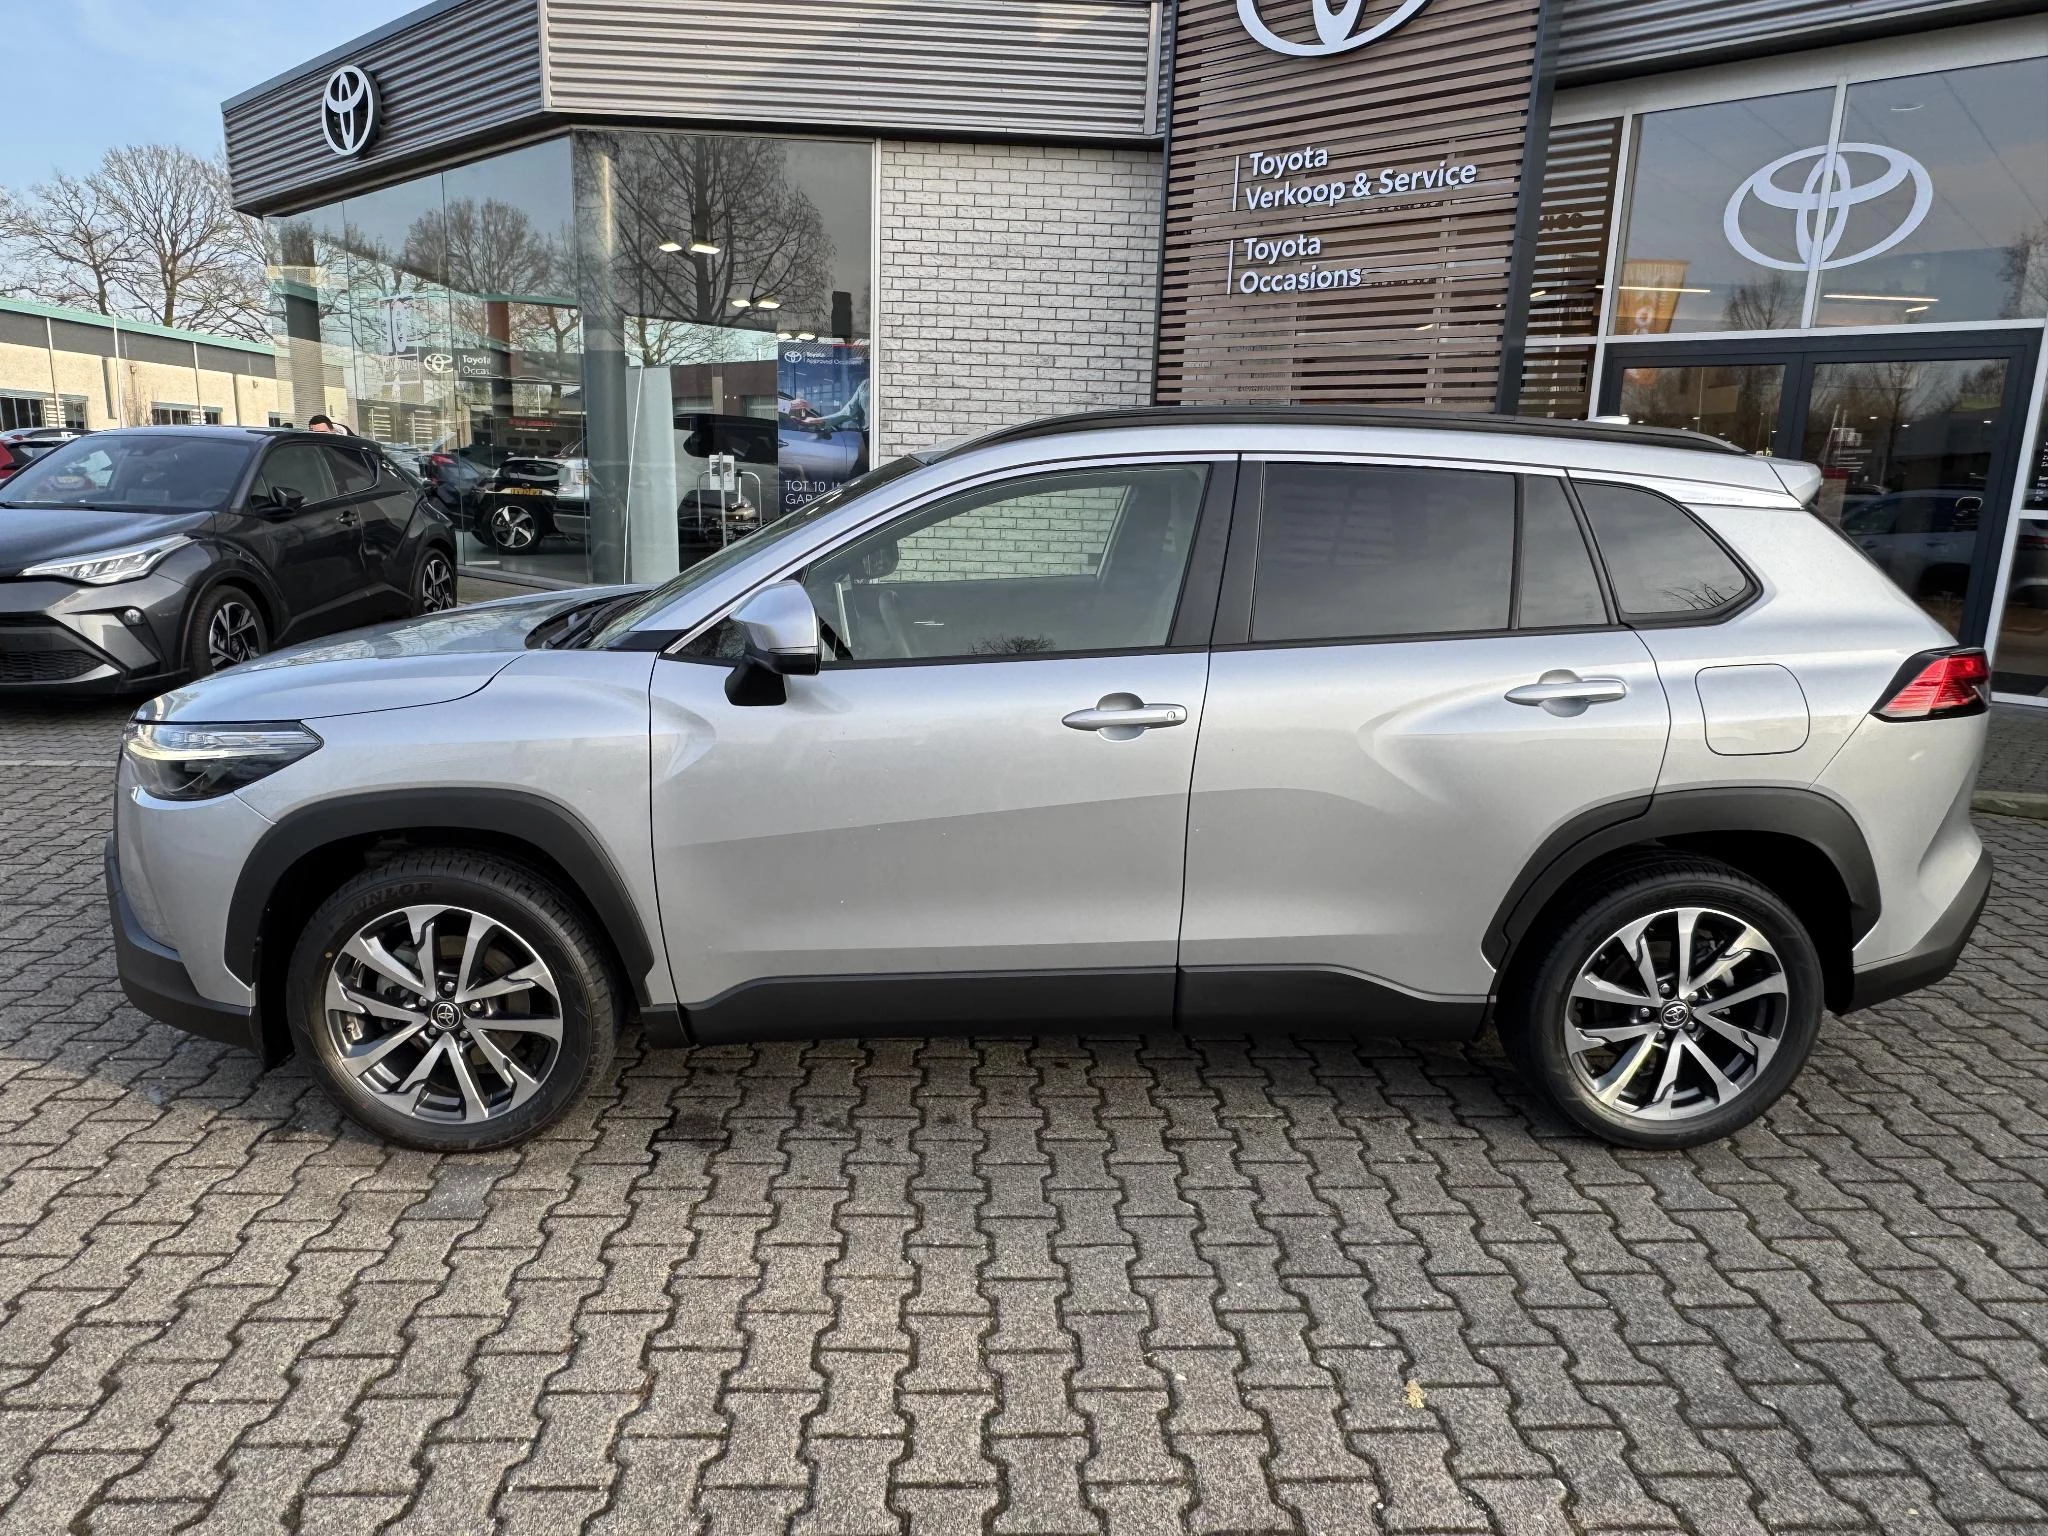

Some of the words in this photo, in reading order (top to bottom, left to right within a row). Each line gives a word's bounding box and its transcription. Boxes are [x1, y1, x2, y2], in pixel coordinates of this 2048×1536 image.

[1249, 145, 1329, 179] Toyota
[1245, 180, 1346, 210] Verkoop
[1351, 171, 1373, 197] &
[1378, 160, 1477, 195] Service
[1243, 234, 1321, 265] Toyota
[1240, 264, 1362, 294] Occasions
[462, 354, 490, 366] Toyota
[785, 480, 809, 492] TOT
[812, 481, 826, 493] 10
